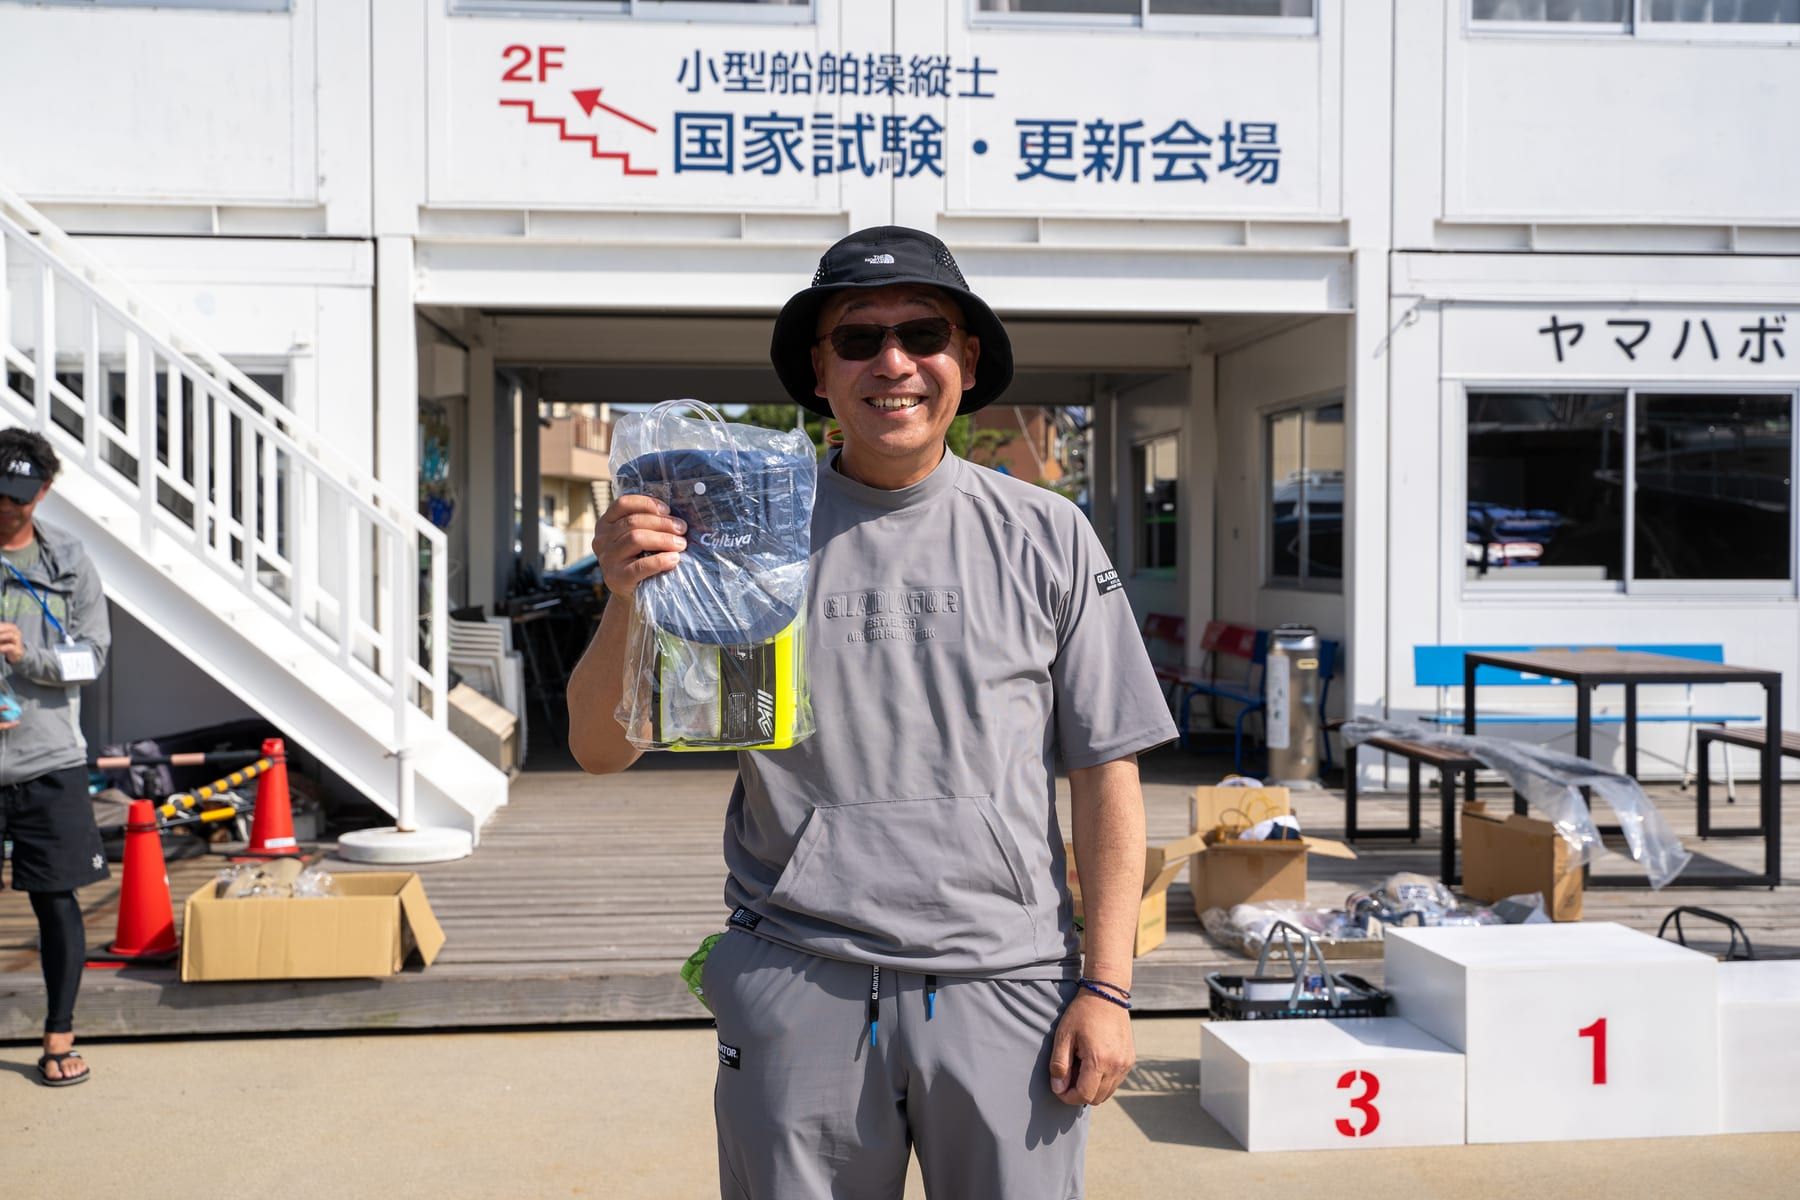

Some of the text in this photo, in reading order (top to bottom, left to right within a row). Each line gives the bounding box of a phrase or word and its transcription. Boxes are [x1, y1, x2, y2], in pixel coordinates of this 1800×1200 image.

[501, 44, 565, 82] 2F
[676, 50, 998, 99] 小型船舶操縦士
[674, 111, 1281, 185] 国家試験・更新会場
[1538, 315, 1787, 363] ヤマハボ
[823, 590, 959, 619] GLADIATOR
[1578, 1017, 1607, 1085] 1
[1335, 1069, 1381, 1137] 3
